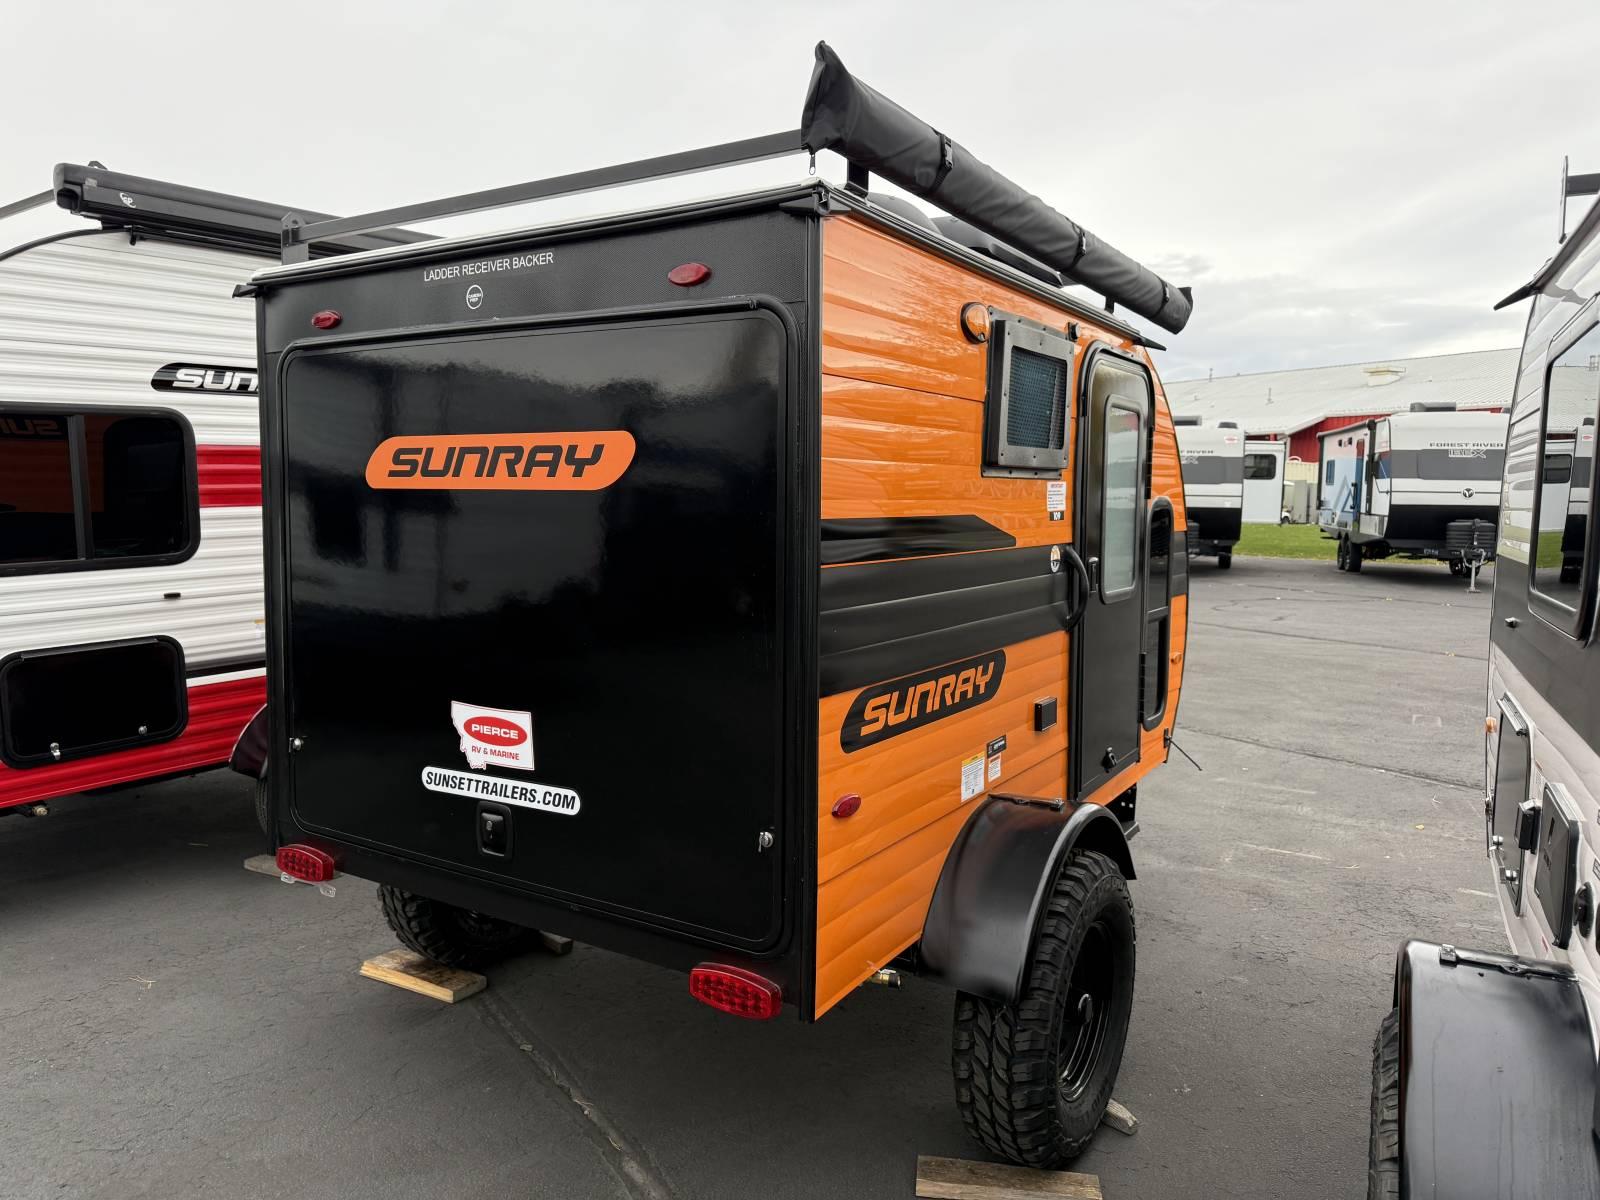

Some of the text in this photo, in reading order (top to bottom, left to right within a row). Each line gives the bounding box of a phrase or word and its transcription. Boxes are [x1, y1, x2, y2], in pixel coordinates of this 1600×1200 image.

[424, 252, 554, 281] LADDER RECEIVER BACKER
[387, 443, 605, 478] SUNRAY
[860, 661, 995, 736] SUNRAY
[471, 723, 519, 740] PIERCE
[471, 745, 520, 761] RV & MARINE
[425, 771, 576, 810] SUNSETTRAILERS.COM
